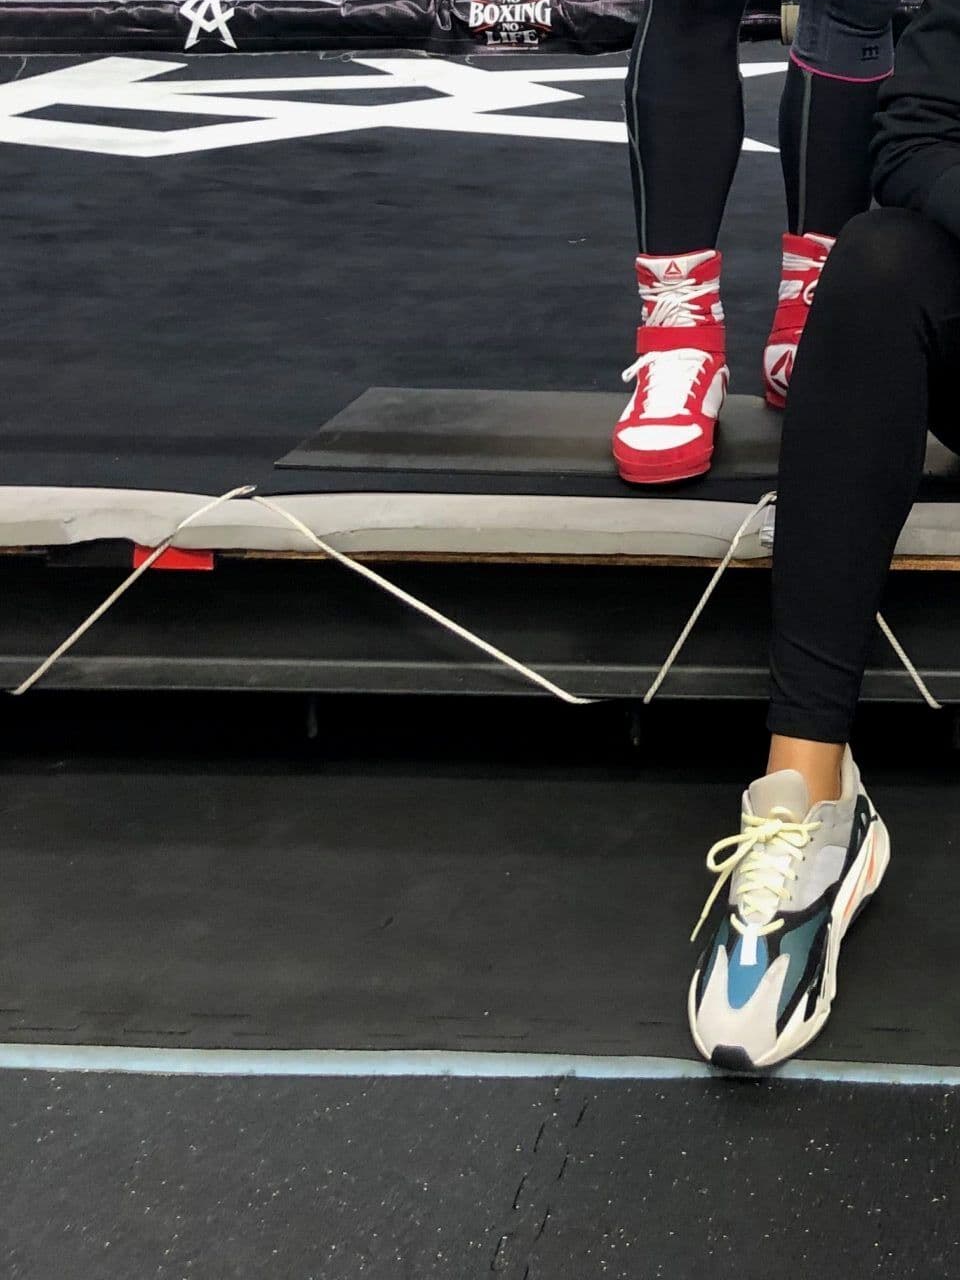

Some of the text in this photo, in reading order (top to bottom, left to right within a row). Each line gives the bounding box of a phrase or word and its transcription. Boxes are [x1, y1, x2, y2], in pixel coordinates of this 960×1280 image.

[469, 0, 552, 27] BOXING
[502, 23, 519, 31] NO
[485, 30, 539, 45] LIFE
